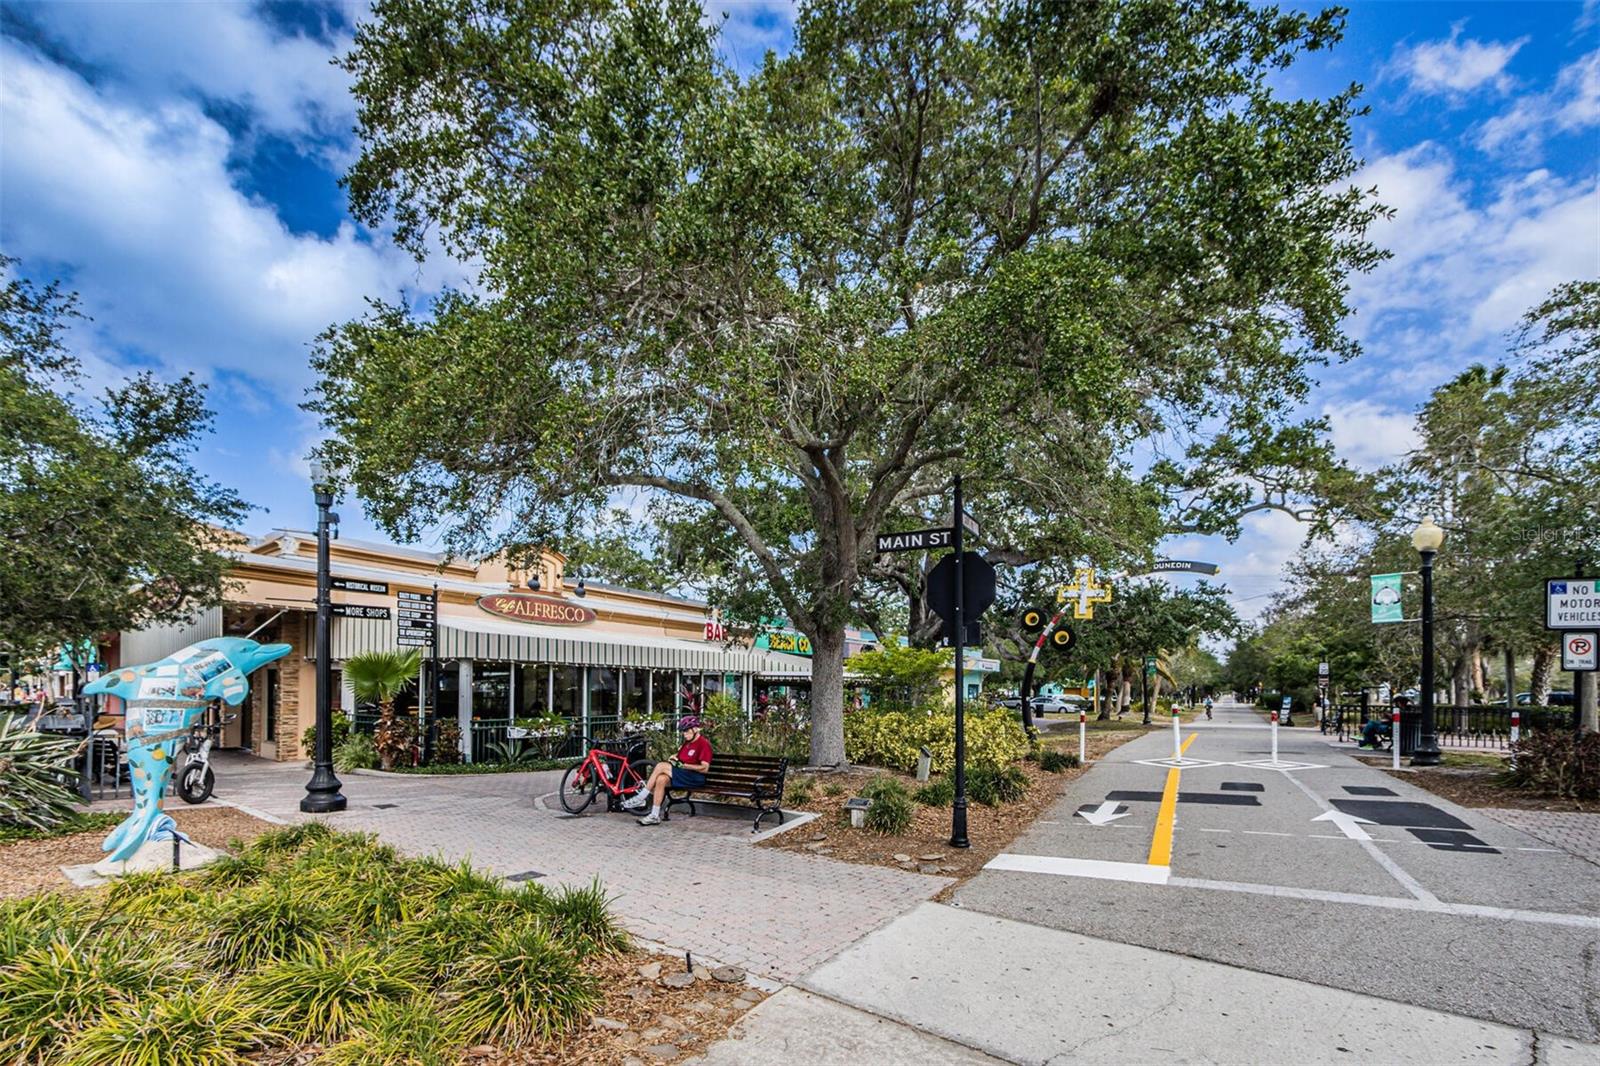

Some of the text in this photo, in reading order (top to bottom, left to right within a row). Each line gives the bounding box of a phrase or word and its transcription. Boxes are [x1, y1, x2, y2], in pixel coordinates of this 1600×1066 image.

[879, 532, 951, 550] MAIN ST
[1153, 562, 1192, 570] DUNEDIN
[1572, 585, 1589, 595] NO
[1560, 599, 1600, 609] MOTOR
[345, 606, 364, 617] MORE
[366, 608, 388, 618] SHOPS
[514, 600, 585, 623] ALFRESCO
